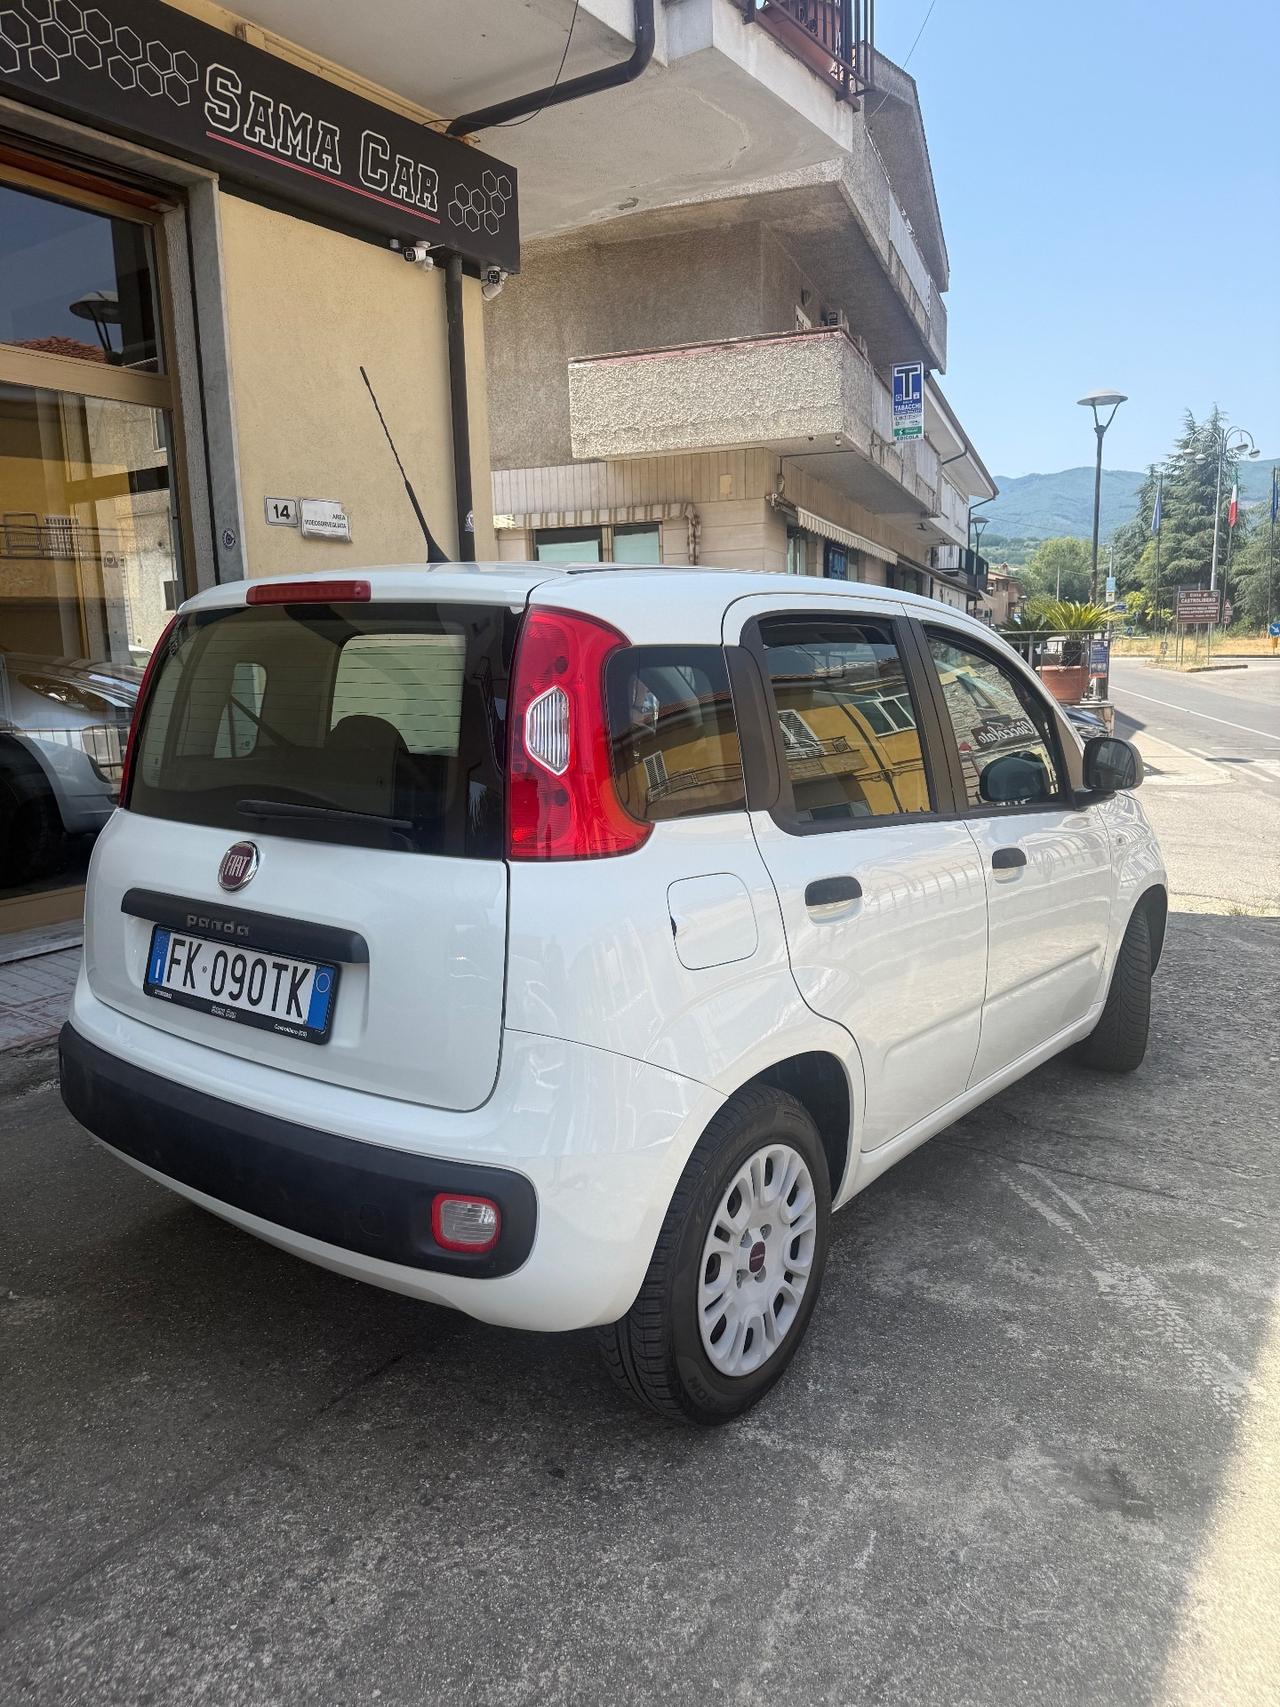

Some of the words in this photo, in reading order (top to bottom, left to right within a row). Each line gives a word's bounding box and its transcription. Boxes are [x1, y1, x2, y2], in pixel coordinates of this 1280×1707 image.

[204, 63, 342, 175] SAMA
[359, 129, 441, 213] CAR
[273, 504, 291, 520] 14
[226, 854, 250, 878] FIAT
[186, 914, 249, 937] panda
